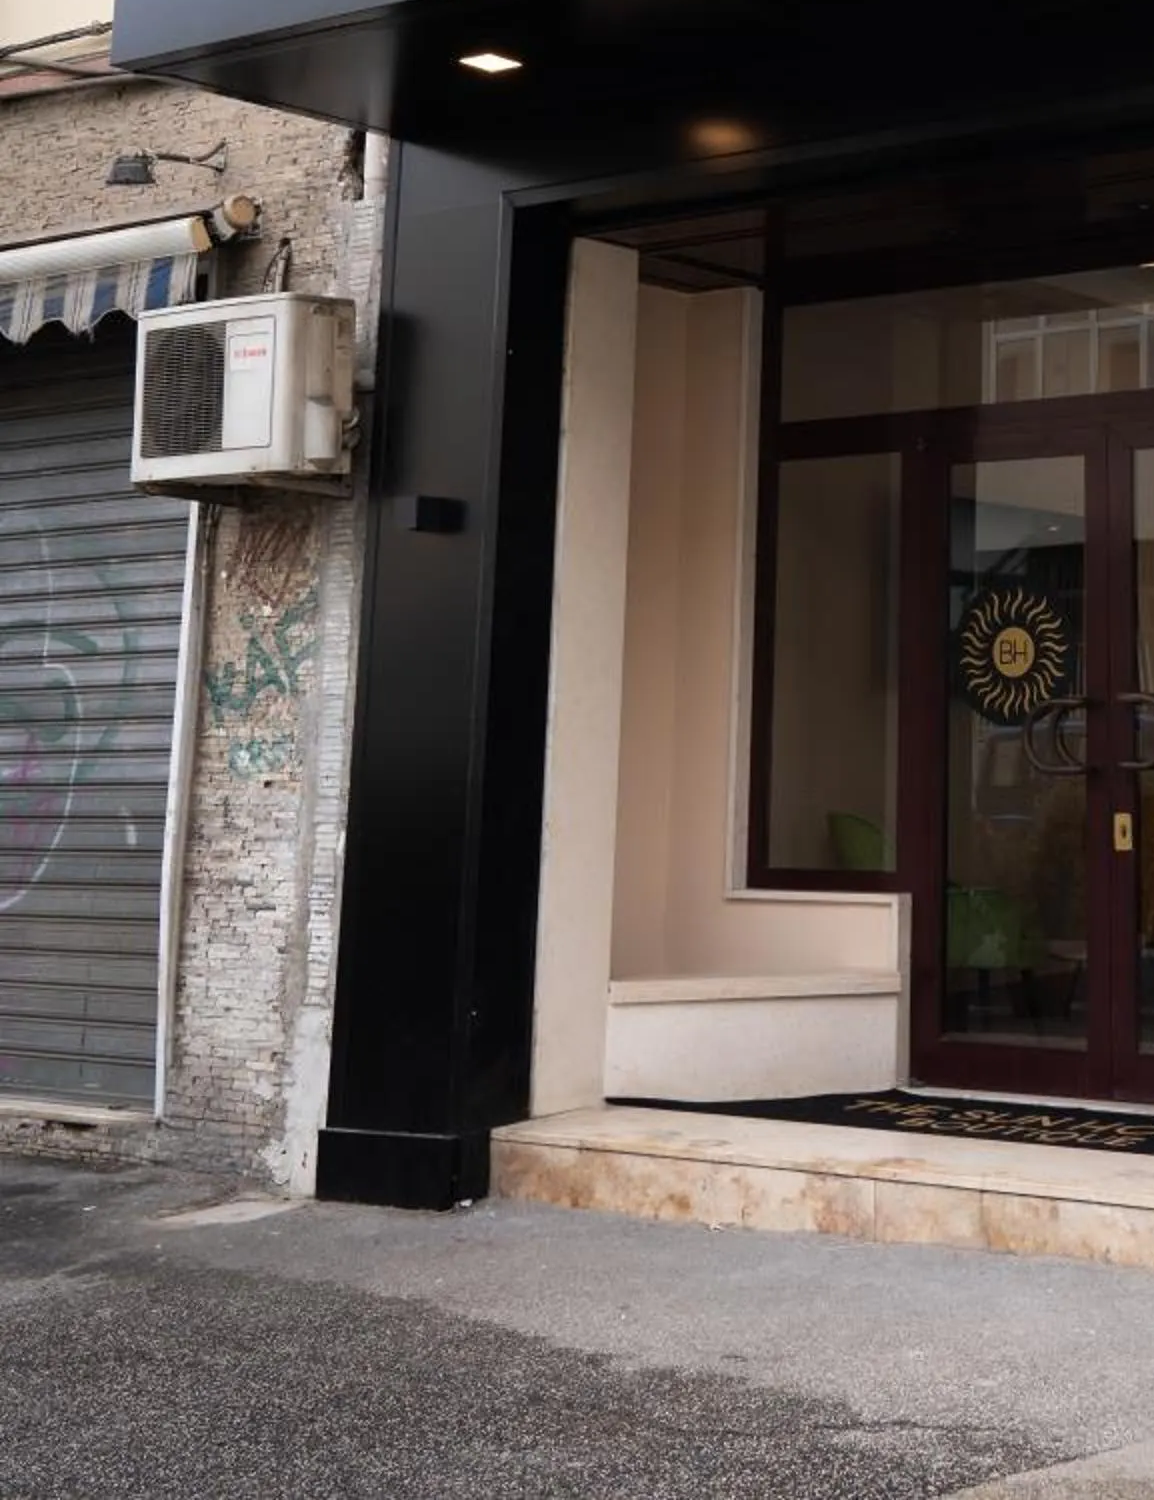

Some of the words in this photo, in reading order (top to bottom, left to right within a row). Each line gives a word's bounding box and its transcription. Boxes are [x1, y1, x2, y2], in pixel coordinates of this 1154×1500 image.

[1000, 637, 1029, 665] BH
[843, 1099, 954, 1117] THE
[949, 1108, 1075, 1128] SUN
[896, 1117, 1147, 1148] BOUTIQUE
